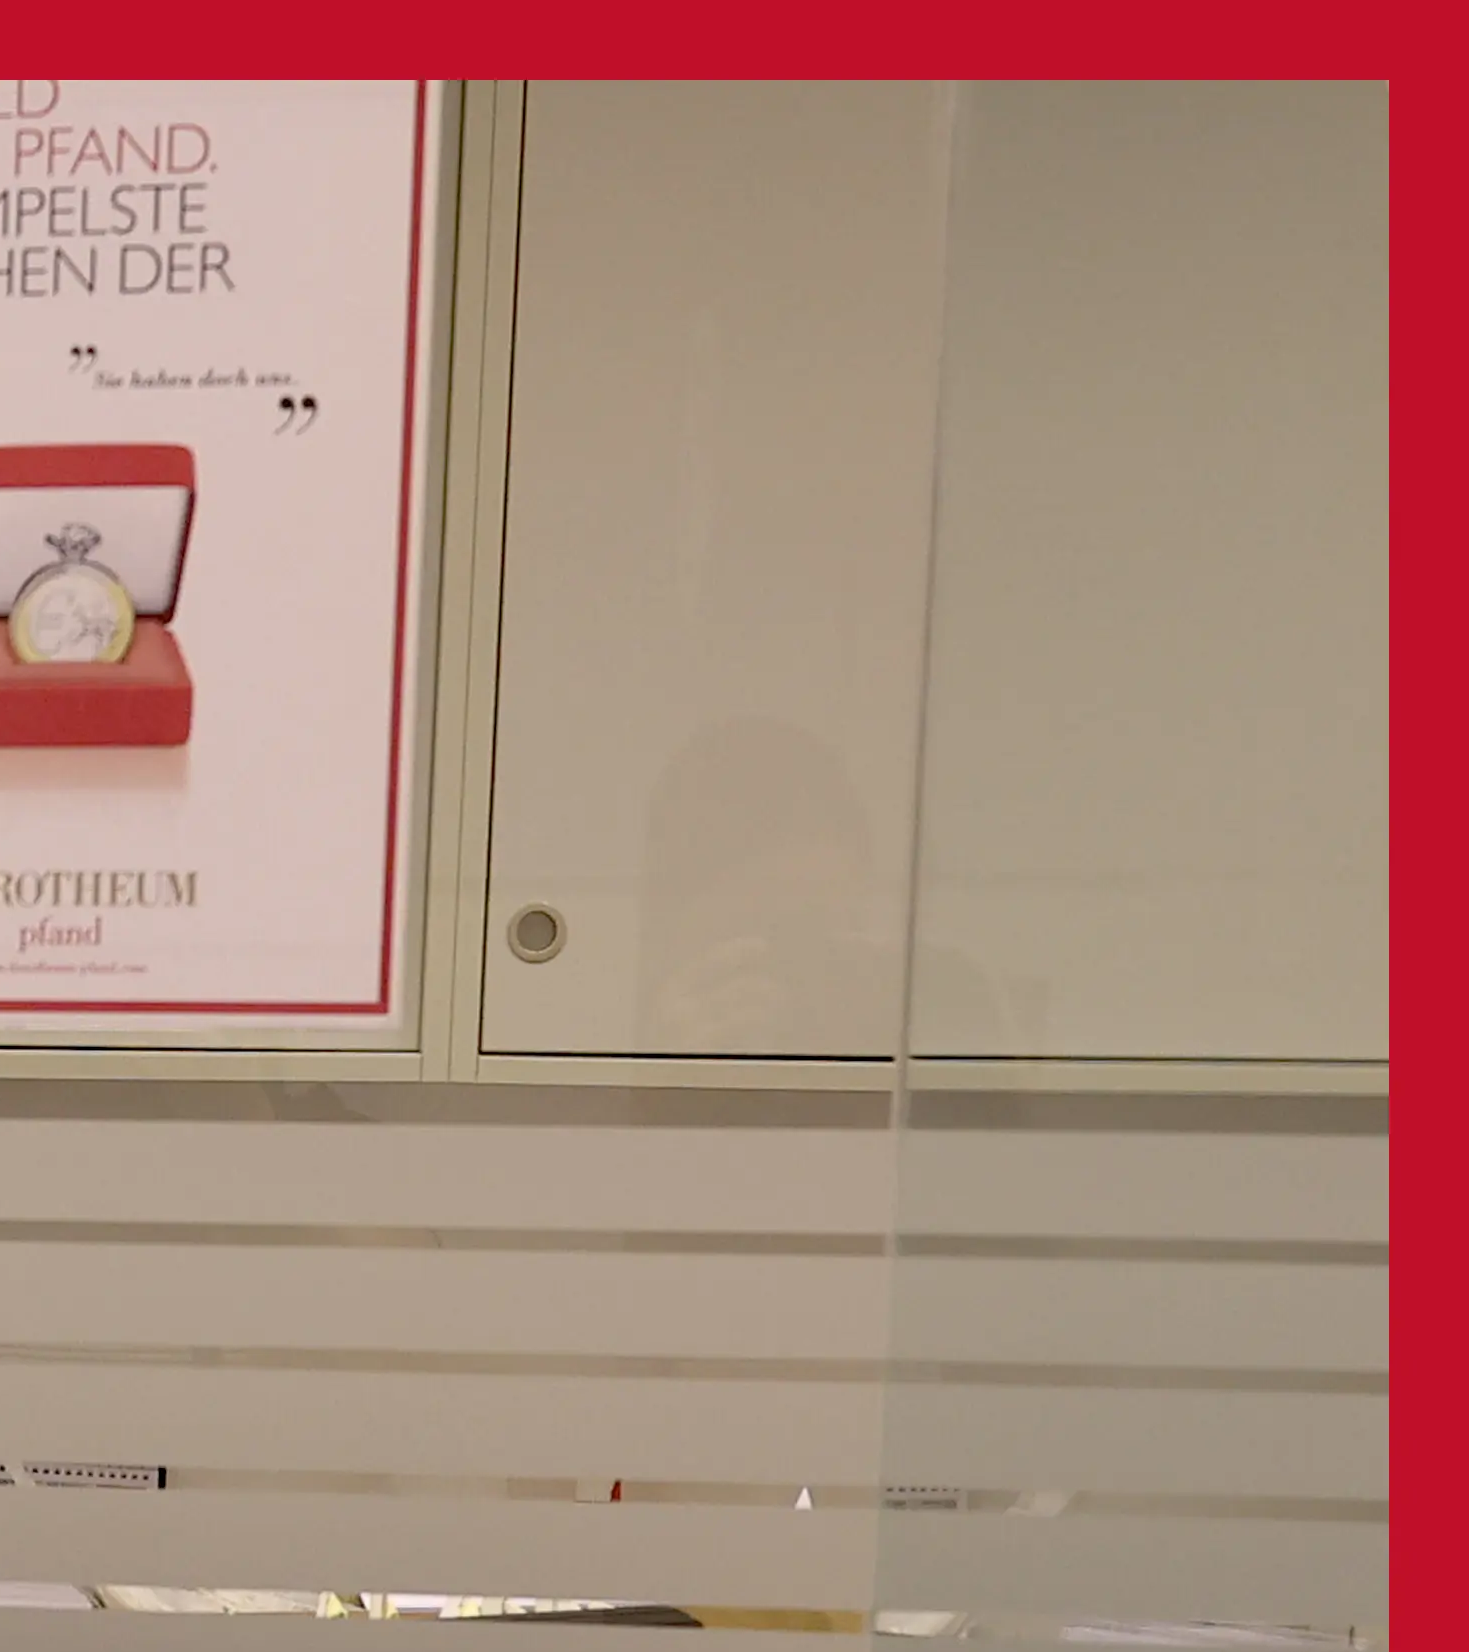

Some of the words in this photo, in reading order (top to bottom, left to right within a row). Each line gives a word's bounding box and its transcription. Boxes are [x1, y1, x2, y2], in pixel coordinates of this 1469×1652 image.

[13, 121, 220, 178] PFAND.
[117, 240, 237, 297] DER
[17, 915, 103, 954] pfand
